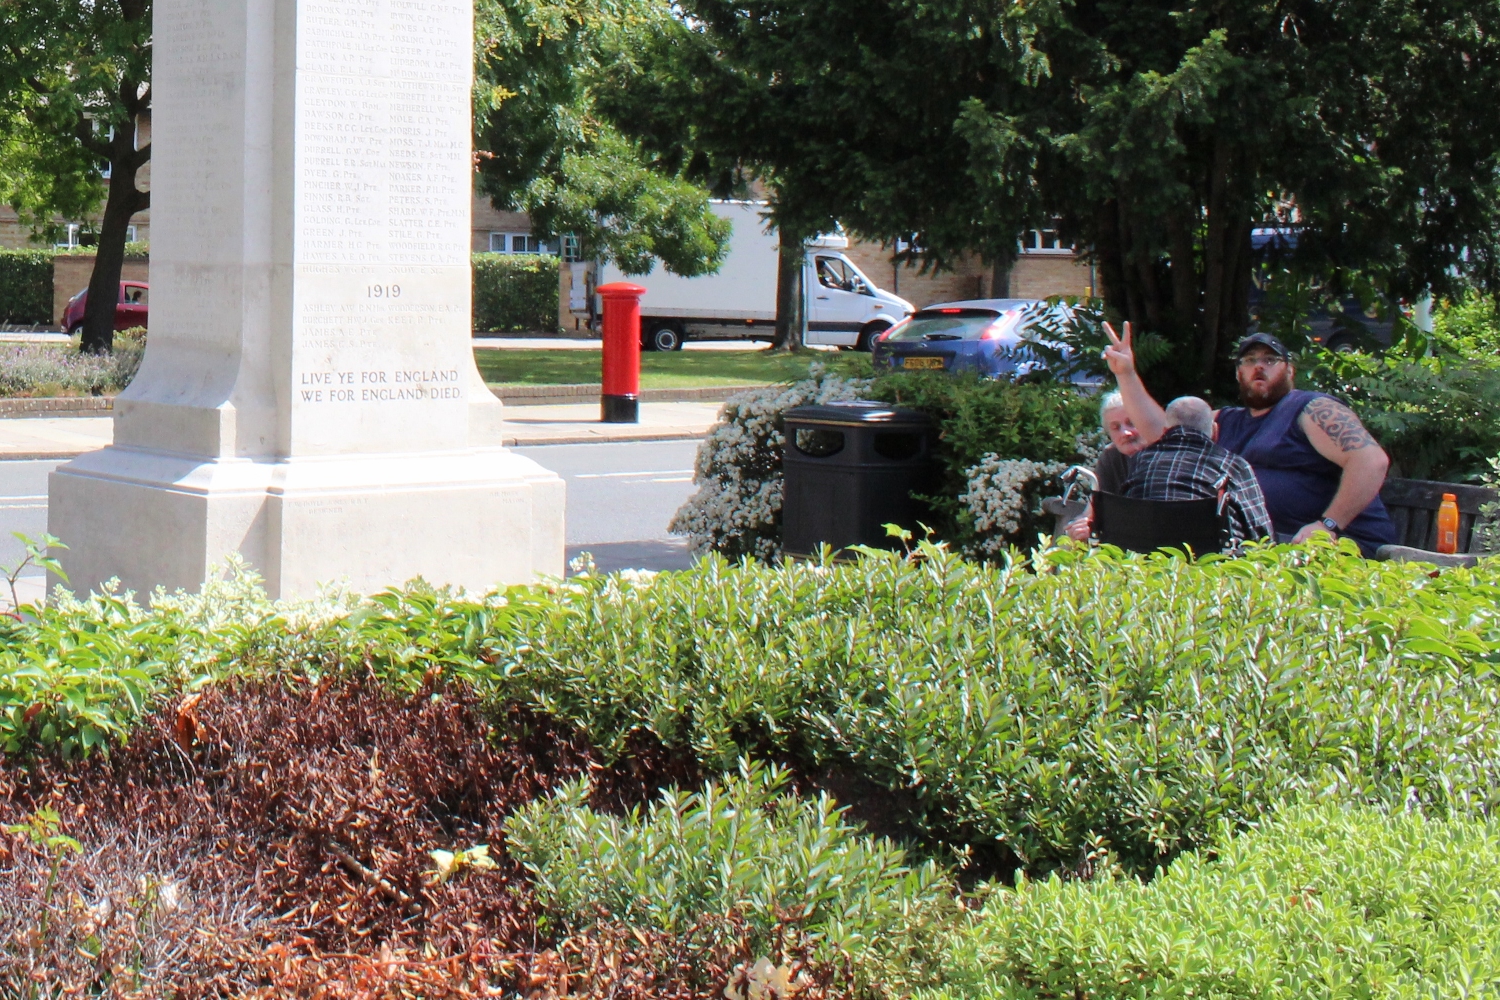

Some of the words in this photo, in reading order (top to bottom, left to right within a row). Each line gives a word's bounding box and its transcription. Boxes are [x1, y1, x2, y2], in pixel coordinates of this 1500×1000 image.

[368, 284, 401, 298] 1919
[301, 372, 333, 384] LIVE
[337, 372, 354, 384] YE
[362, 371, 387, 383] FOR
[395, 370, 458, 383] ENGLAND
[301, 390, 323, 403] WE
[330, 389, 355, 402] FOR
[362, 388, 424, 401] ENGLAND
[431, 387, 463, 400] DIED.
